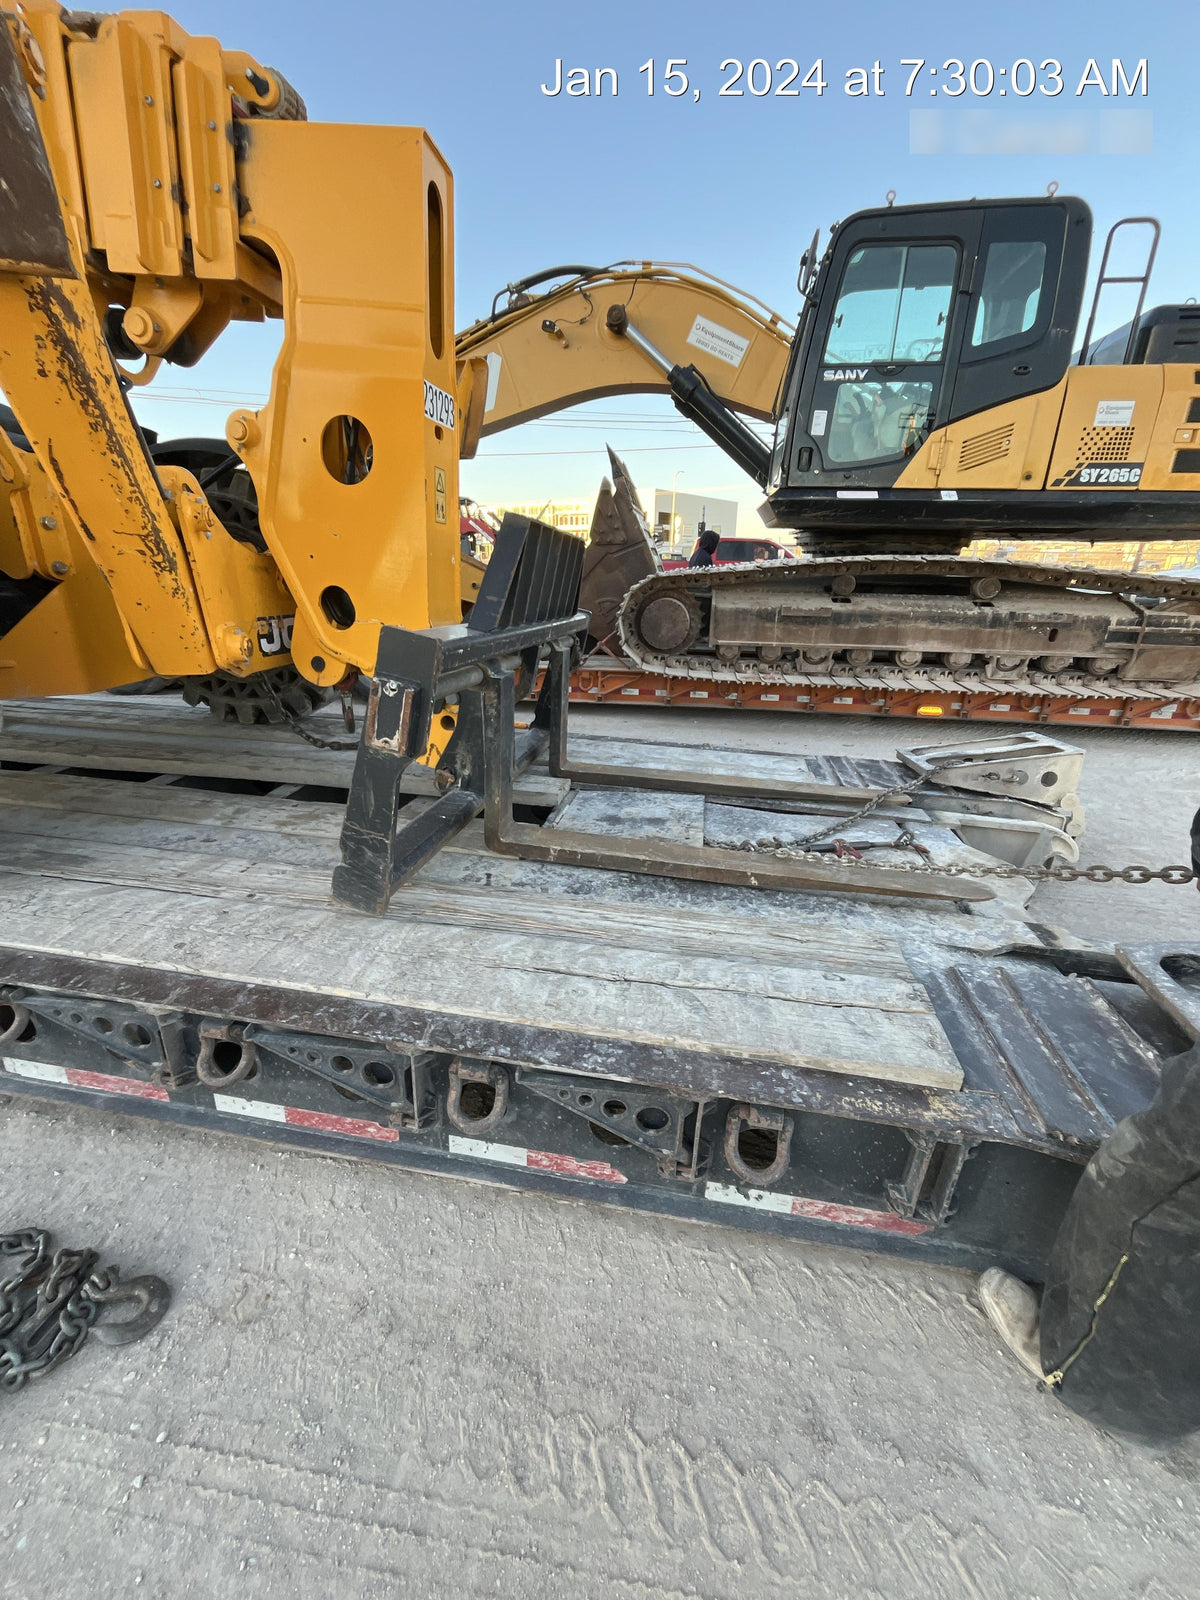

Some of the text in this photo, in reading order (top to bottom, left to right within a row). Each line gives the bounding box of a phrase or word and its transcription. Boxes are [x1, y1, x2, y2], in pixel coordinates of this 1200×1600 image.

[823, 368, 869, 381] SANY
[1079, 467, 1141, 483] SY265C
[259, 617, 295, 653] JC
